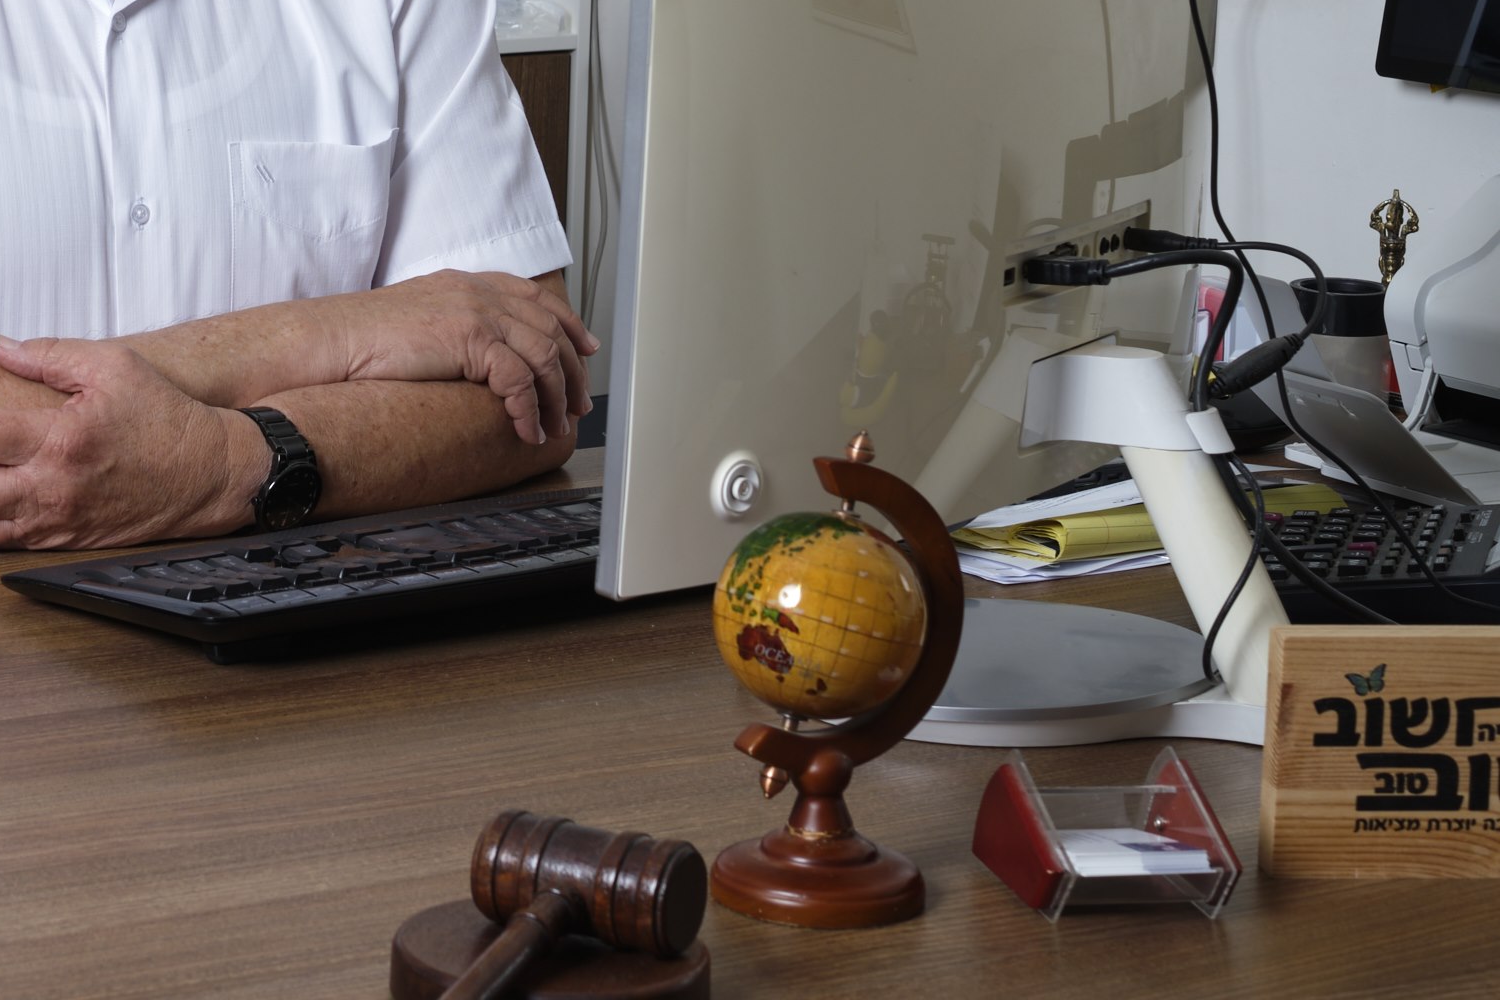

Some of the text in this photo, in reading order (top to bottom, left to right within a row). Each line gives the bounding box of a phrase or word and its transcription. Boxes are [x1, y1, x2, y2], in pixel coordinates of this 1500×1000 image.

[1355, 753, 1500, 811] וב
[1374, 772, 1429, 794] טוב
[1354, 817, 1420, 832] מציאות
[1426, 817, 1476, 832] יוצרת
